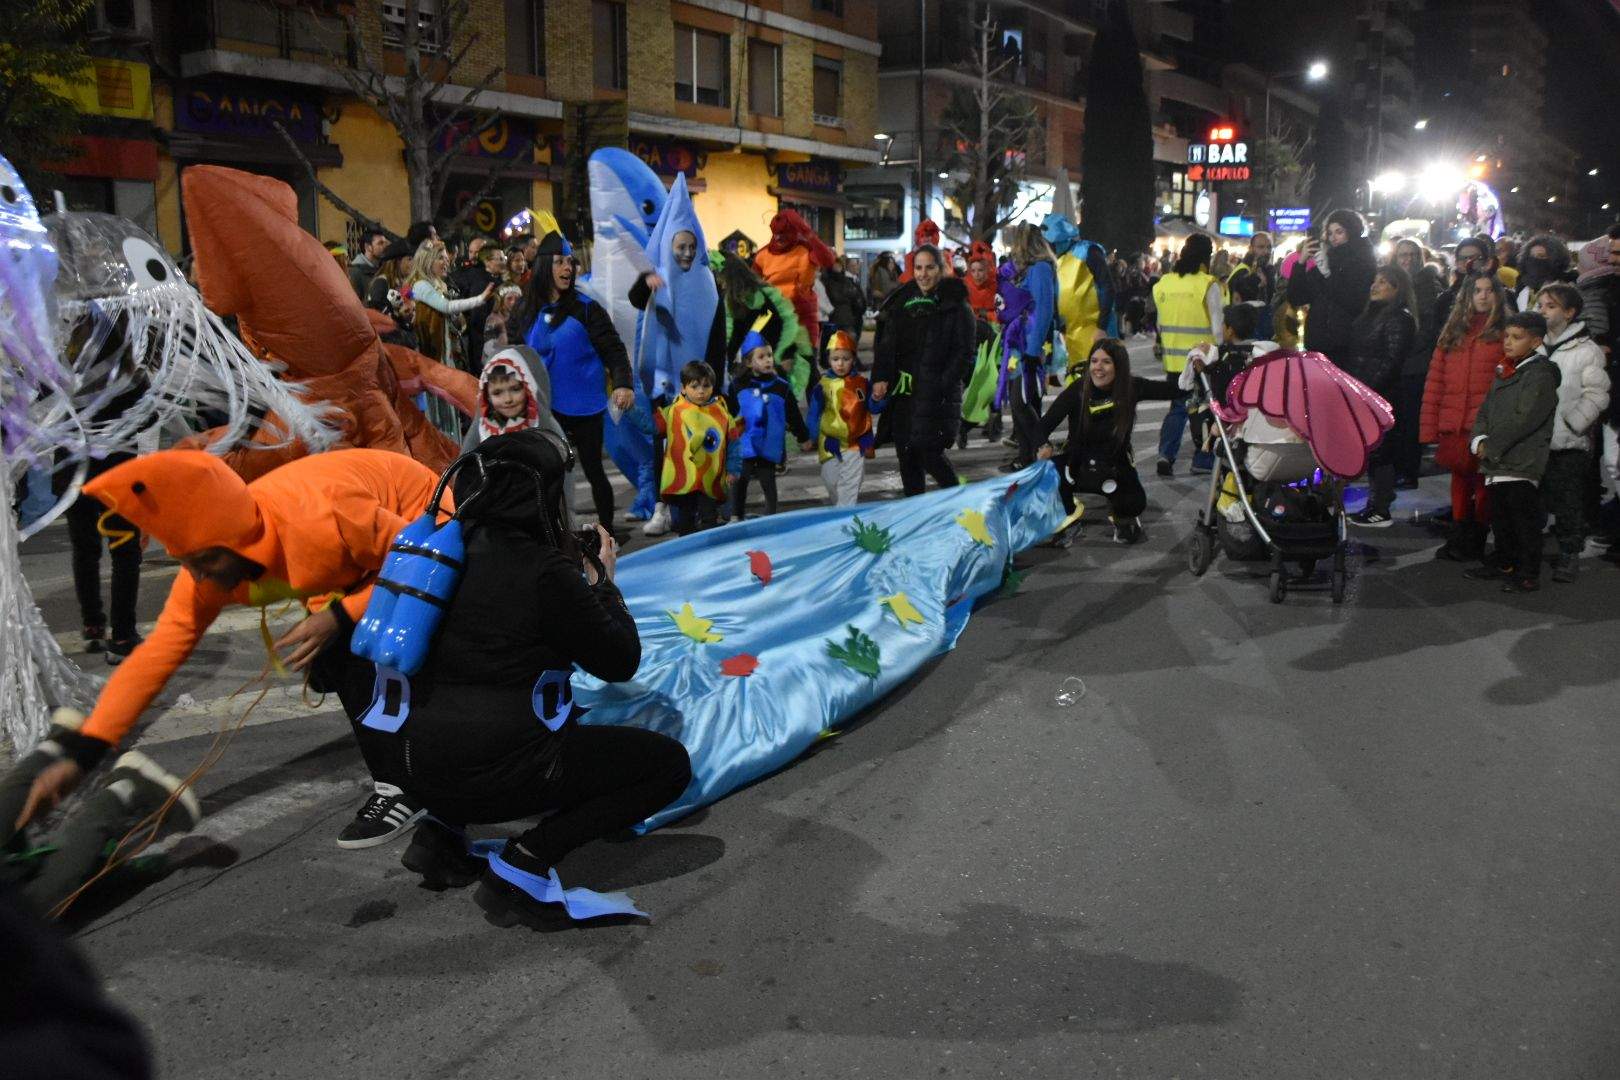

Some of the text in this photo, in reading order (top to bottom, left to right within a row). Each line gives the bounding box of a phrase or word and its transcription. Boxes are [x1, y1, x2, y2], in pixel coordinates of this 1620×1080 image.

[1208, 143, 1247, 163] BAR
[787, 166, 832, 184] GANGA
[1206, 167, 1249, 180] ACAPULCO
